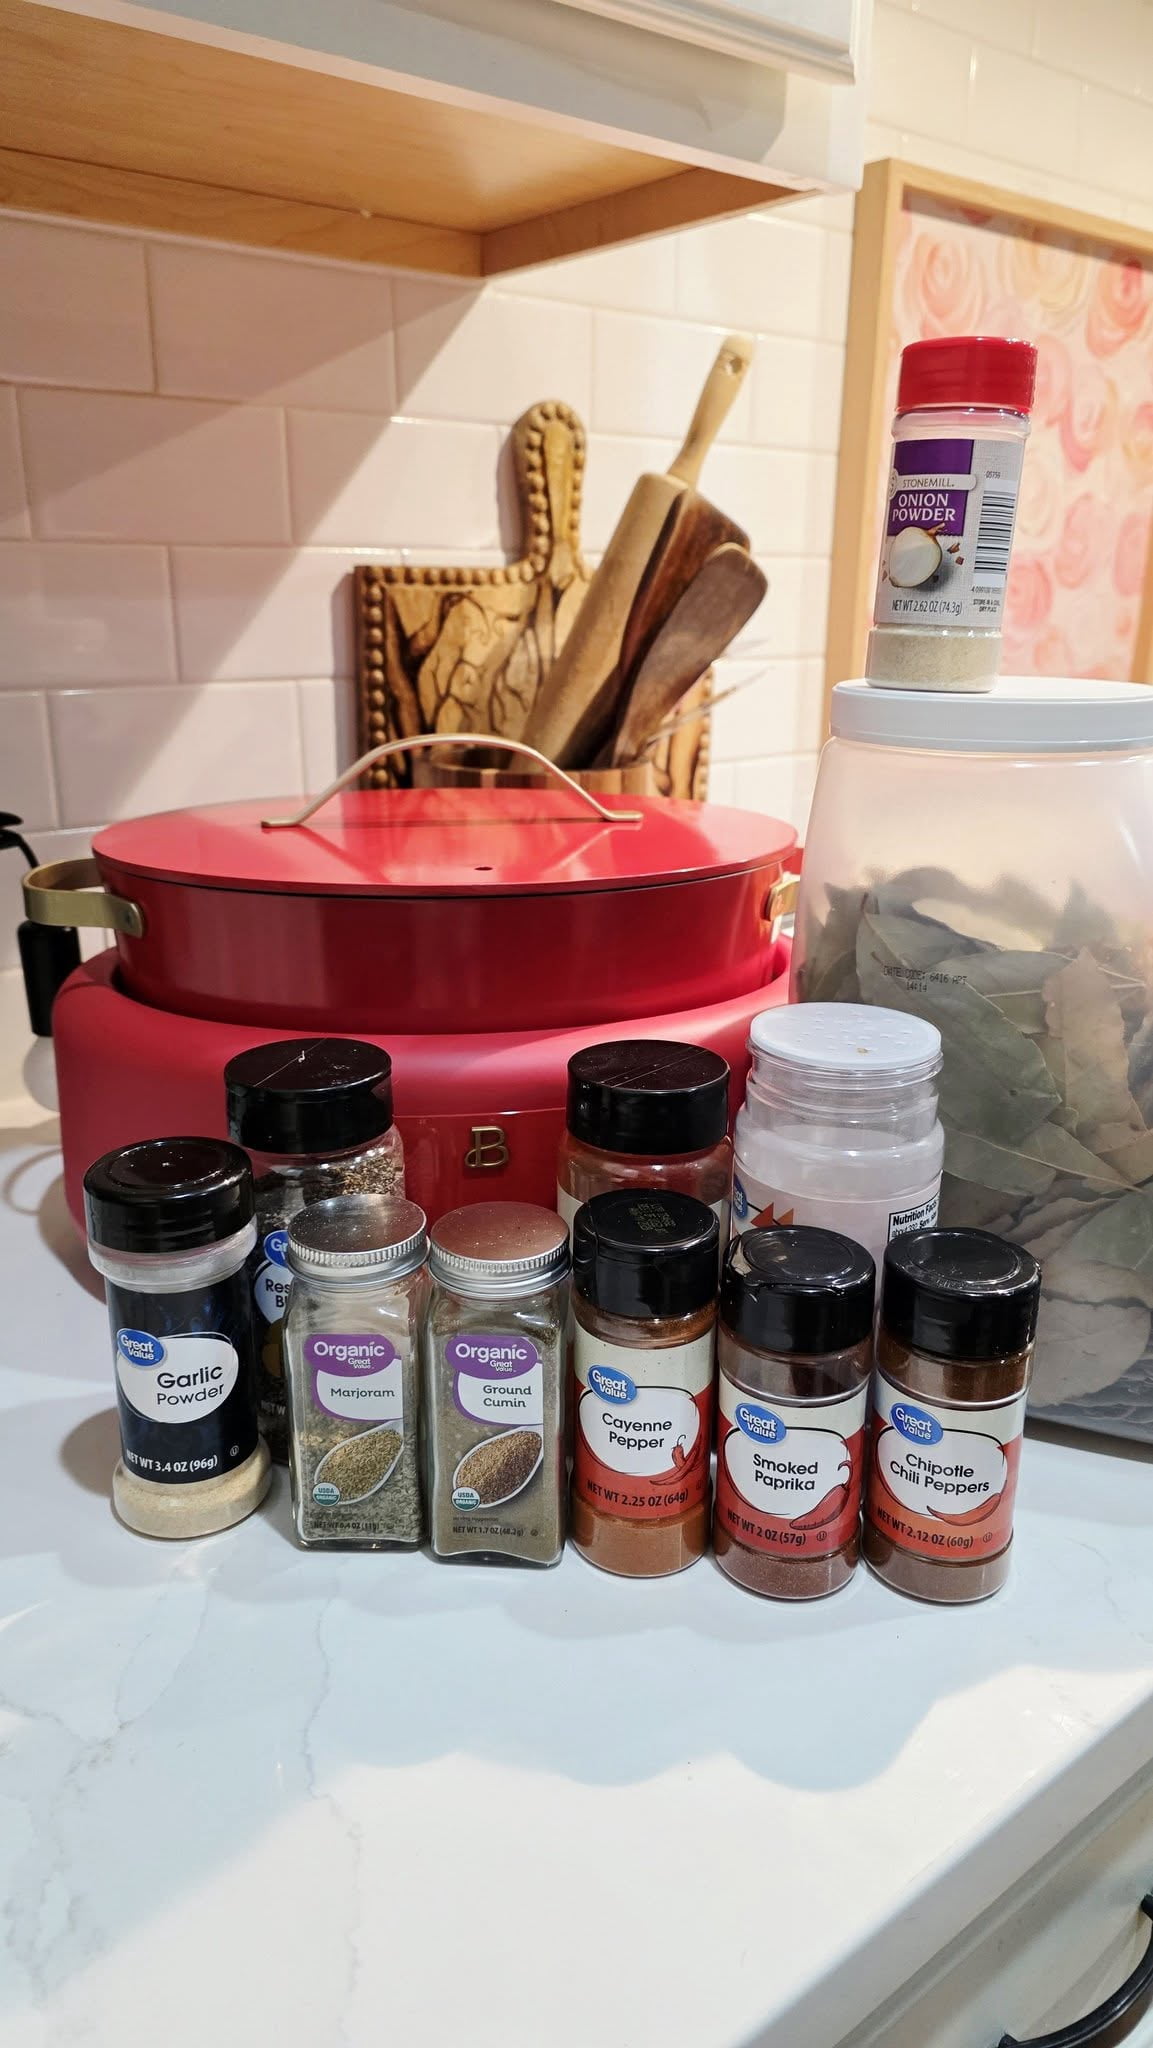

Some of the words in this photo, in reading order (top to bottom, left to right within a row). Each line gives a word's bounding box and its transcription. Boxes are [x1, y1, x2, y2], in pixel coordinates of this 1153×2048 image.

[898, 493, 949, 507] ONION
[892, 508, 956, 521] POWDER
[892, 600, 902, 611] NET
[903, 600, 912, 611] WT
[914, 600, 928, 612] 2.62
[929, 600, 939, 612] OZ
[940, 600, 963, 616] (74.3g)
[892, 1208, 925, 1226] Nutrition
[120, 1334, 154, 1352] Great
[127, 1348, 154, 1360] Value
[157, 1366, 223, 1389] Garlic
[592, 1370, 628, 1392] Great
[157, 1384, 224, 1405] Powder
[330, 1388, 395, 1399] Marjoram
[483, 1385, 532, 1395] Ground
[600, 1384, 627, 1399] Value
[483, 1398, 527, 1408] Cumin
[602, 1413, 673, 1432] Cayenne
[740, 1408, 777, 1431] Great
[895, 1407, 932, 1433] Great
[747, 1422, 776, 1440] Value
[902, 1422, 932, 1440] Value
[609, 1431, 665, 1451] Pepper
[126, 1448, 139, 1465] NET
[139, 1456, 154, 1470] WT
[155, 1461, 172, 1472] 3.4
[173, 1461, 188, 1472] OZ
[189, 1454, 218, 1472] (96g)
[753, 1453, 819, 1475] Smoked
[906, 1454, 975, 1478] Chipotle
[755, 1470, 816, 1491] Paprika
[890, 1460, 920, 1485] Chili
[924, 1476, 990, 1496] Peppers
[587, 1480, 602, 1497] NET
[603, 1488, 620, 1503] WT
[622, 1496, 645, 1507] 2.25
[647, 1496, 662, 1507] OZ
[663, 1488, 689, 1506] (64g)
[453, 1526, 465, 1534] NET
[466, 1526, 477, 1534] WT
[478, 1526, 489, 1534] 1.7
[727, 1508, 742, 1526] NET
[741, 1518, 757, 1534] WT
[756, 1526, 762, 1537] 2
[764, 1529, 778, 1542] OZ
[779, 1531, 807, 1547] (57g)
[877, 1507, 892, 1525] NET
[892, 1519, 906, 1533] WT
[906, 1526, 929, 1543] 2.12
[931, 1534, 945, 1546] OZ
[946, 1536, 974, 1549] (60g)
